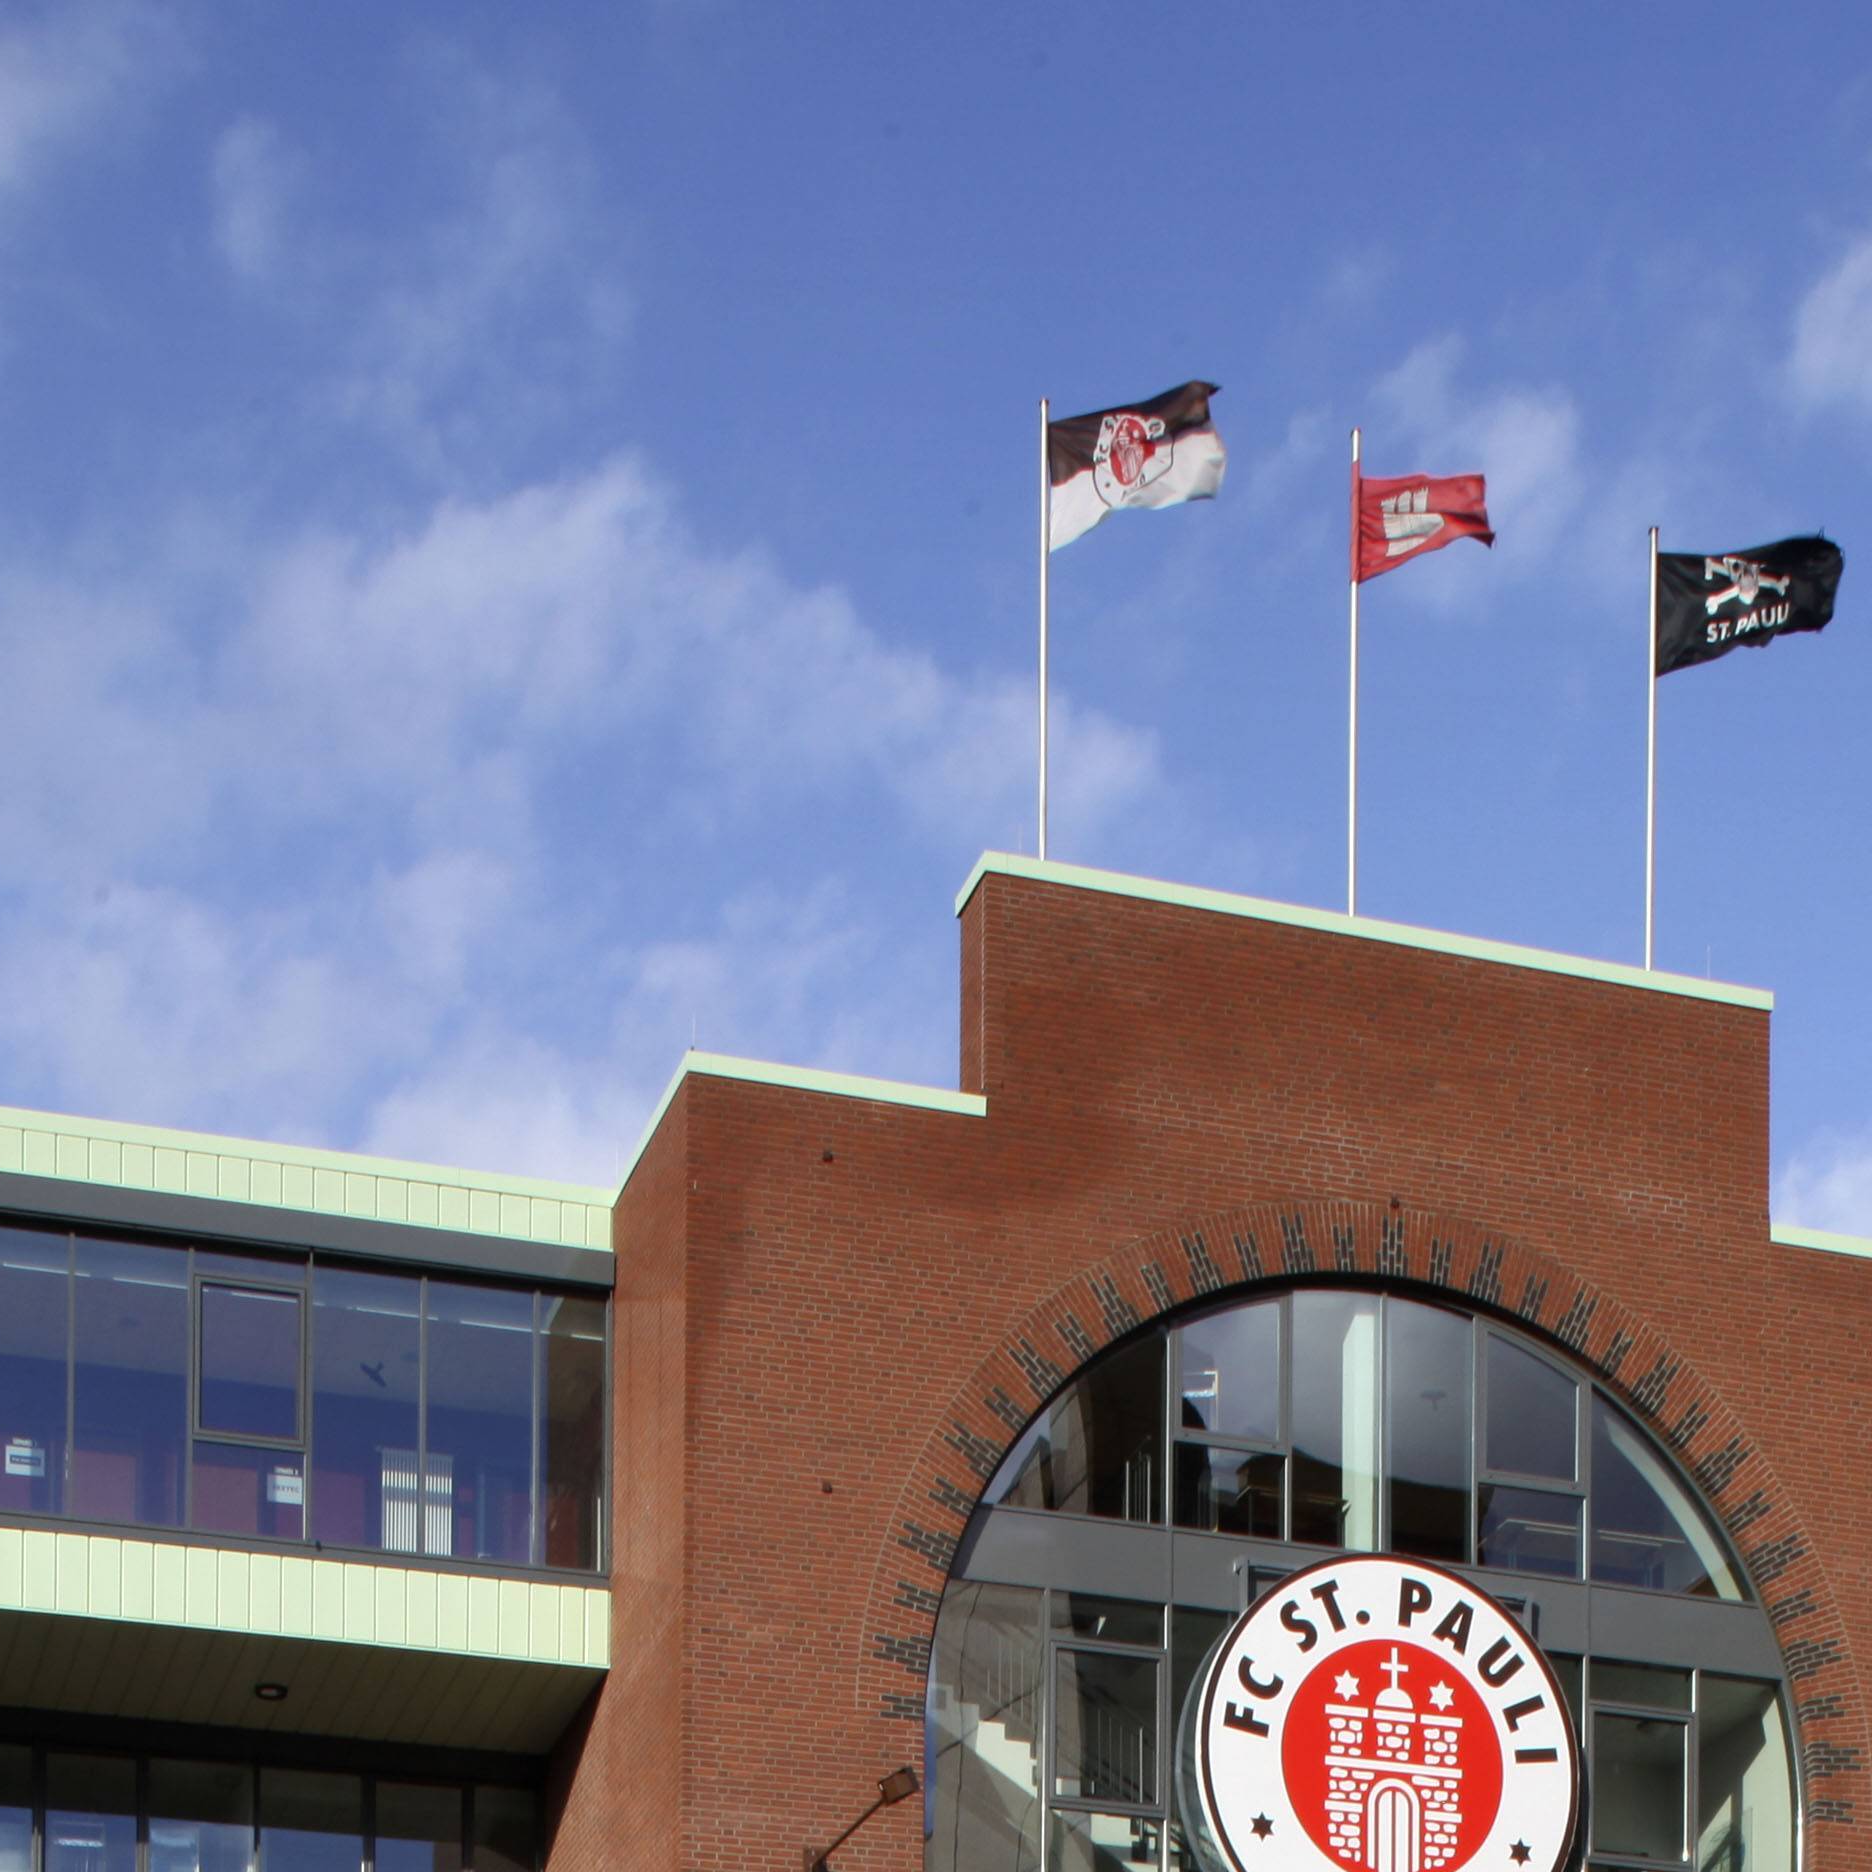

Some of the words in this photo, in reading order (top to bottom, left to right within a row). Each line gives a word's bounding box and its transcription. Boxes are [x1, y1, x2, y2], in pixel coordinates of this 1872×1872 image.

[1707, 621, 1731, 643] ST.
[1224, 1655, 1284, 1738] FC
[1280, 1579, 1370, 1652] ST.
[1398, 1577, 1559, 1764] PAULI
